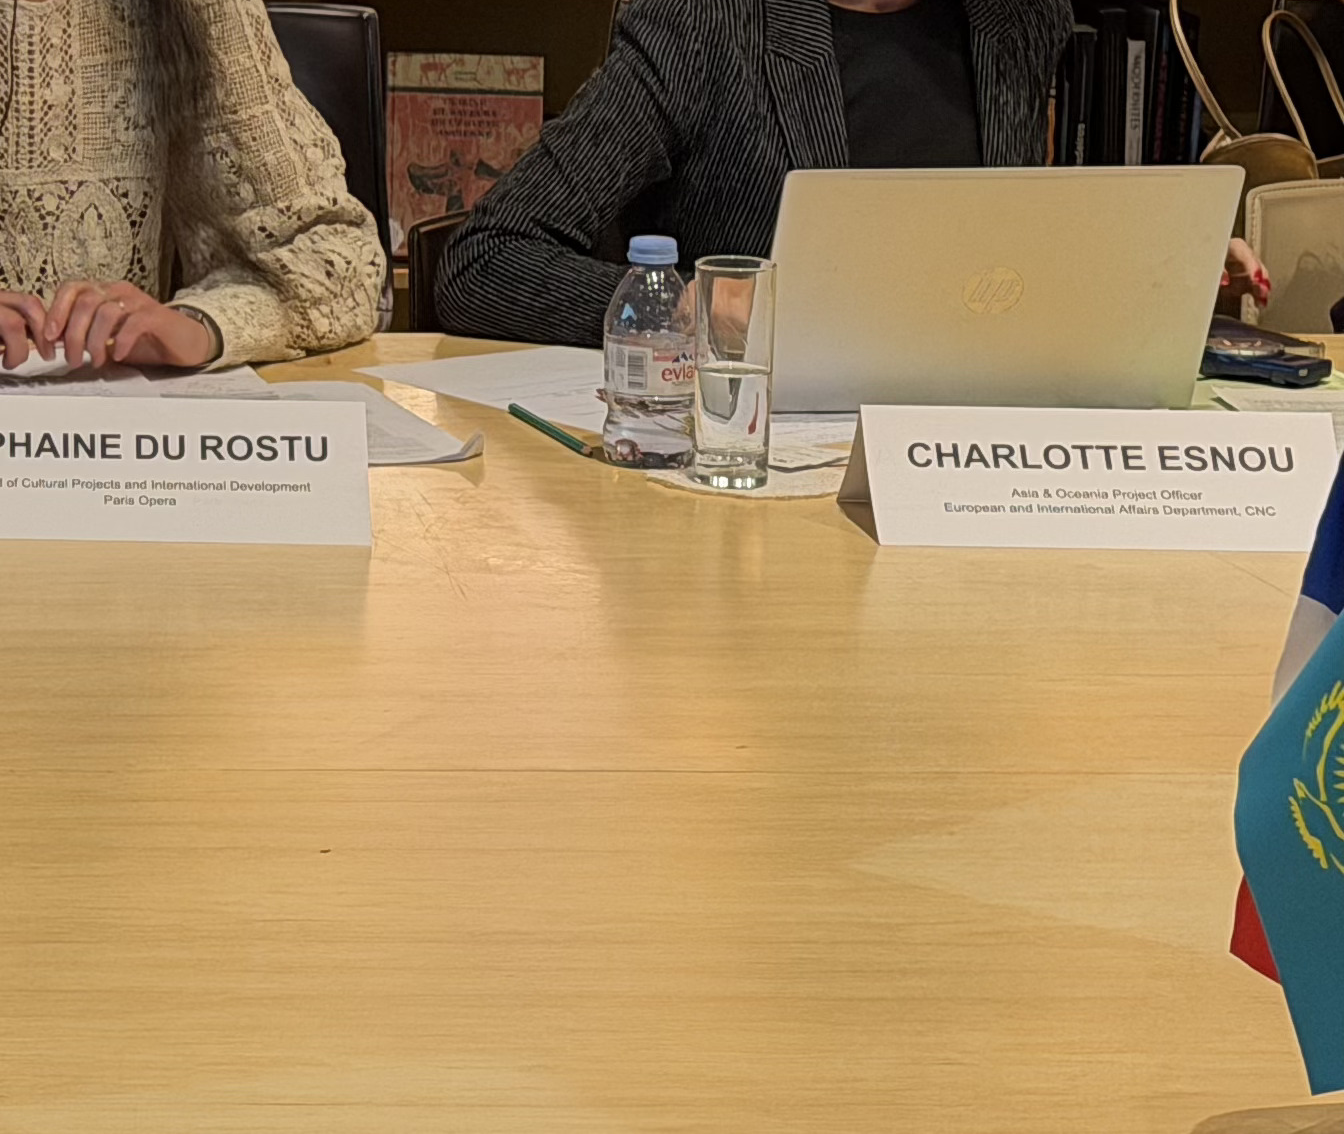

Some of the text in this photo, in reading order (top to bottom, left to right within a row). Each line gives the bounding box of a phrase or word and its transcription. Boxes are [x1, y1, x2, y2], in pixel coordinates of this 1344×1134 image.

[135, 434, 185, 460] DU
[200, 435, 329, 462] ROSTU
[906, 442, 1295, 473] CHARLOTTE ESNOU
[6, 478, 19, 489] of
[21, 478, 68, 490] Cultural
[72, 478, 121, 492] Projects
[125, 479, 147, 491] and
[151, 479, 226, 491] International
[230, 480, 311, 494] Development
[103, 494, 177, 508] Paris Opera
[1011, 488, 1202, 503] Asia & Oceania Project Officer
[944, 501, 1276, 518] European and International Affairs Department, CNC
